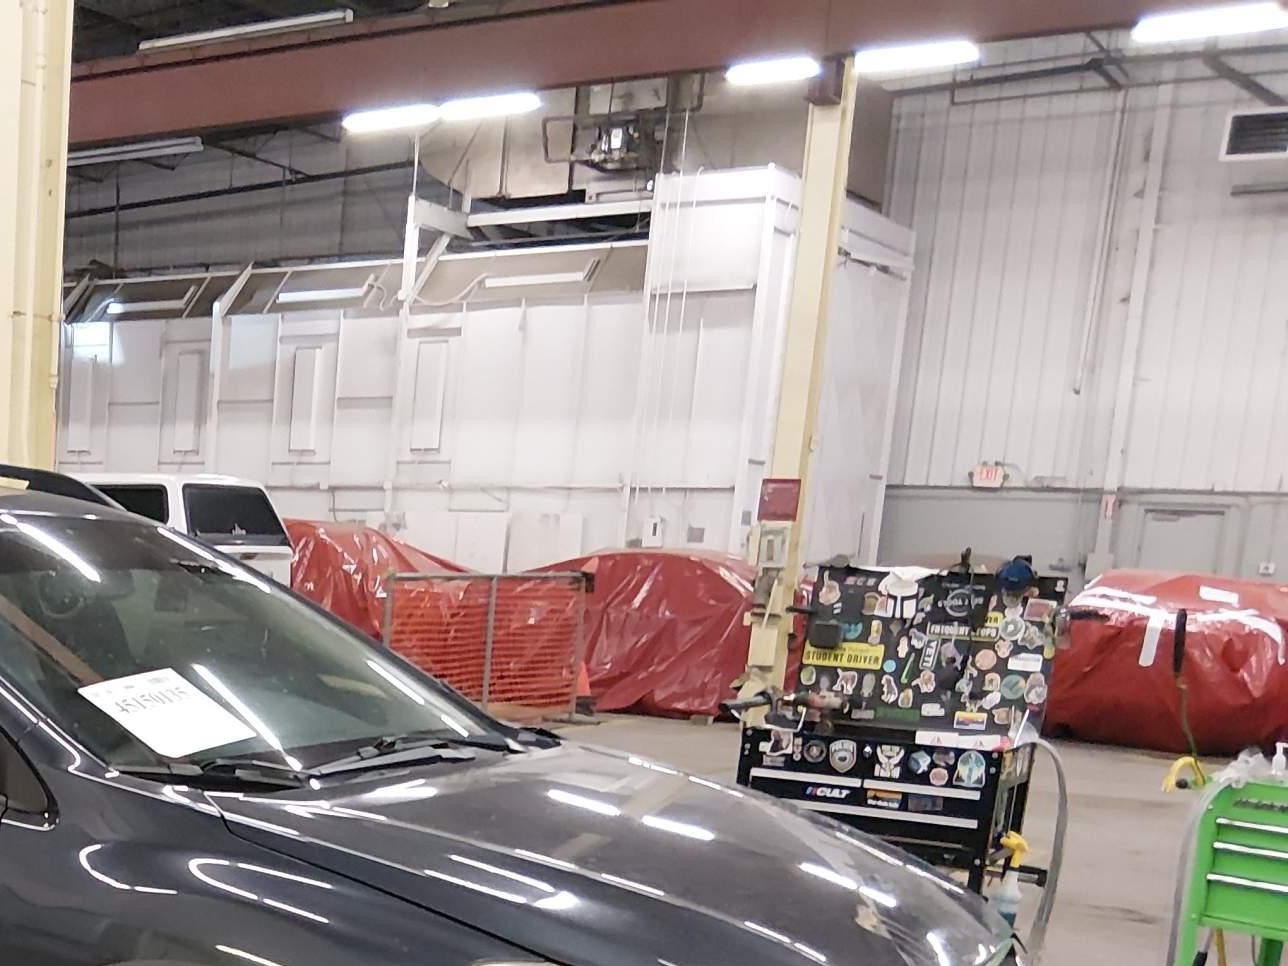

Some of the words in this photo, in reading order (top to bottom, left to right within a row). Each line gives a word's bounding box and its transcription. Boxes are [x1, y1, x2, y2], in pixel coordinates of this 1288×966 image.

[805, 650, 845, 663] STUDENT
[847, 653, 881, 665] DRIVER
[922, 640, 938, 667] YETI
[114, 686, 188, 714] 45150135
